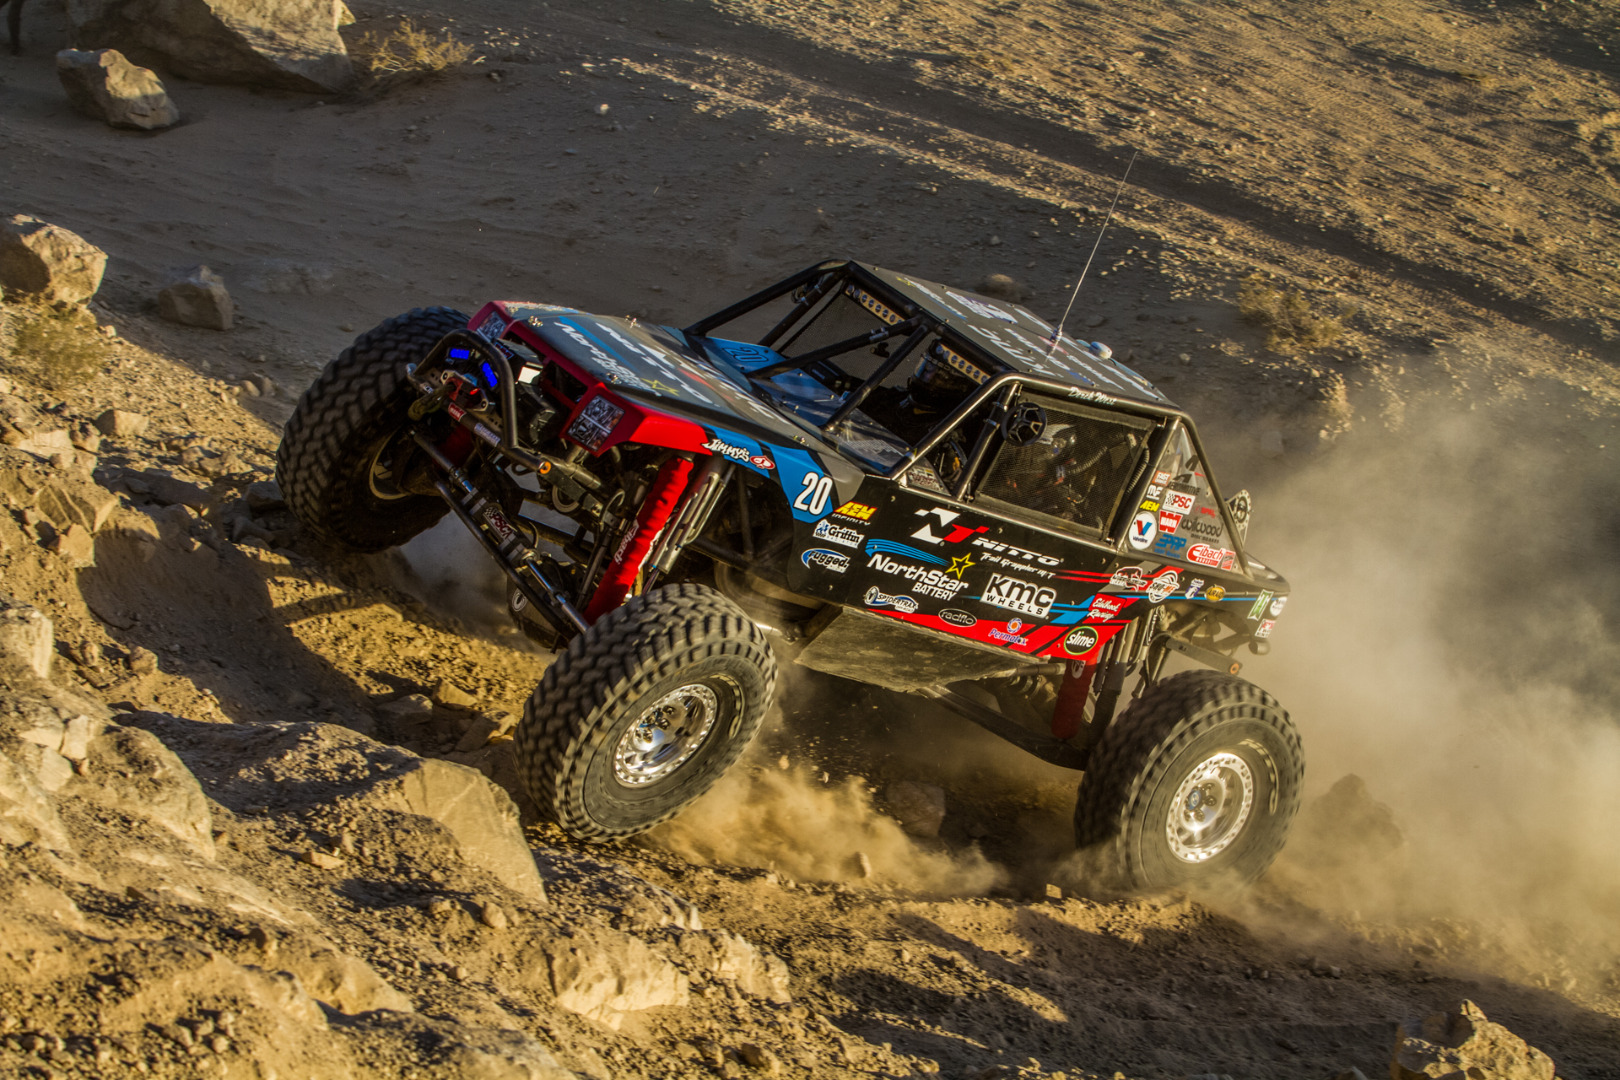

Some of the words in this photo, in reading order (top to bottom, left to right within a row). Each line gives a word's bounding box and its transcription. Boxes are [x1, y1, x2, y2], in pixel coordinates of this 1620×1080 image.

[793, 471, 834, 516] 20
[1170, 495, 1192, 509] PSC
[834, 501, 877, 520] AEM
[828, 526, 860, 543] Griffin
[1187, 544, 1224, 563] Eibach
[866, 553, 969, 592] NorthStar
[1000, 558, 1038, 573] Grappler
[912, 582, 957, 601] BATTERY
[986, 594, 1044, 616] WHEELS
[1066, 630, 1096, 648] slime
